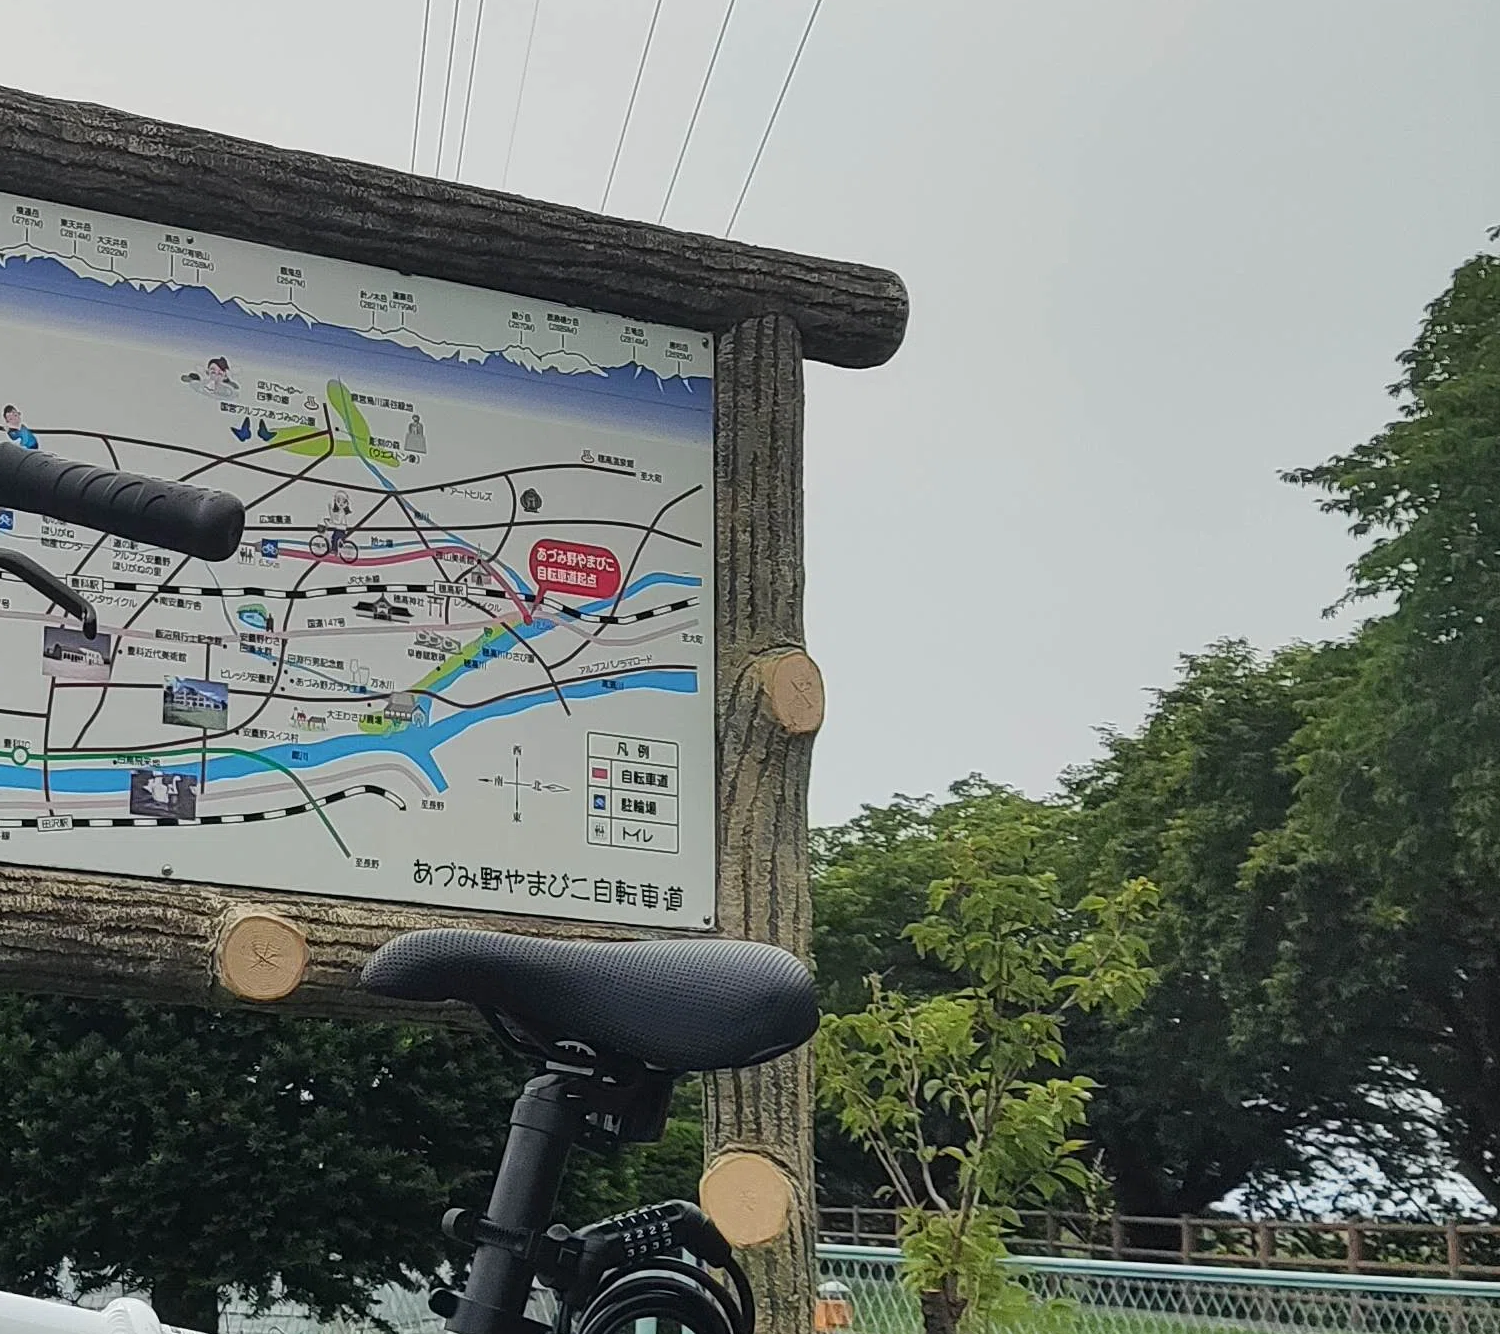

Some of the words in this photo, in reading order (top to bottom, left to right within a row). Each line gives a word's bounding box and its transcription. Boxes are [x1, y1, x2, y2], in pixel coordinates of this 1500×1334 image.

[220, 402, 317, 426] 国営アルプスあづみの公園
[449, 487, 493, 501] アートヒルズ
[112, 549, 171, 566] アルプス安曇野
[537, 547, 616, 572] あづみ野やまびこ
[112, 562, 162, 577] ほりがねの里
[537, 567, 597, 588] 自転車道起点
[86, 592, 138, 608] ンタサイクル
[127, 646, 187, 663] 豊科近代美術館
[578, 655, 653, 675] アルプスパノラマロード
[327, 710, 383, 726] 大王わさび農場
[243, 728, 299, 743] 安曇野スイス村
[512, 745, 522, 756] 西
[621, 769, 669, 788] 自転車道
[620, 797, 657, 816] 駐輪場
[621, 826, 654, 843] トイレ
[354, 856, 380, 870] 至長野
[413, 858, 684, 912] あづみ野やまびこ自転車道
